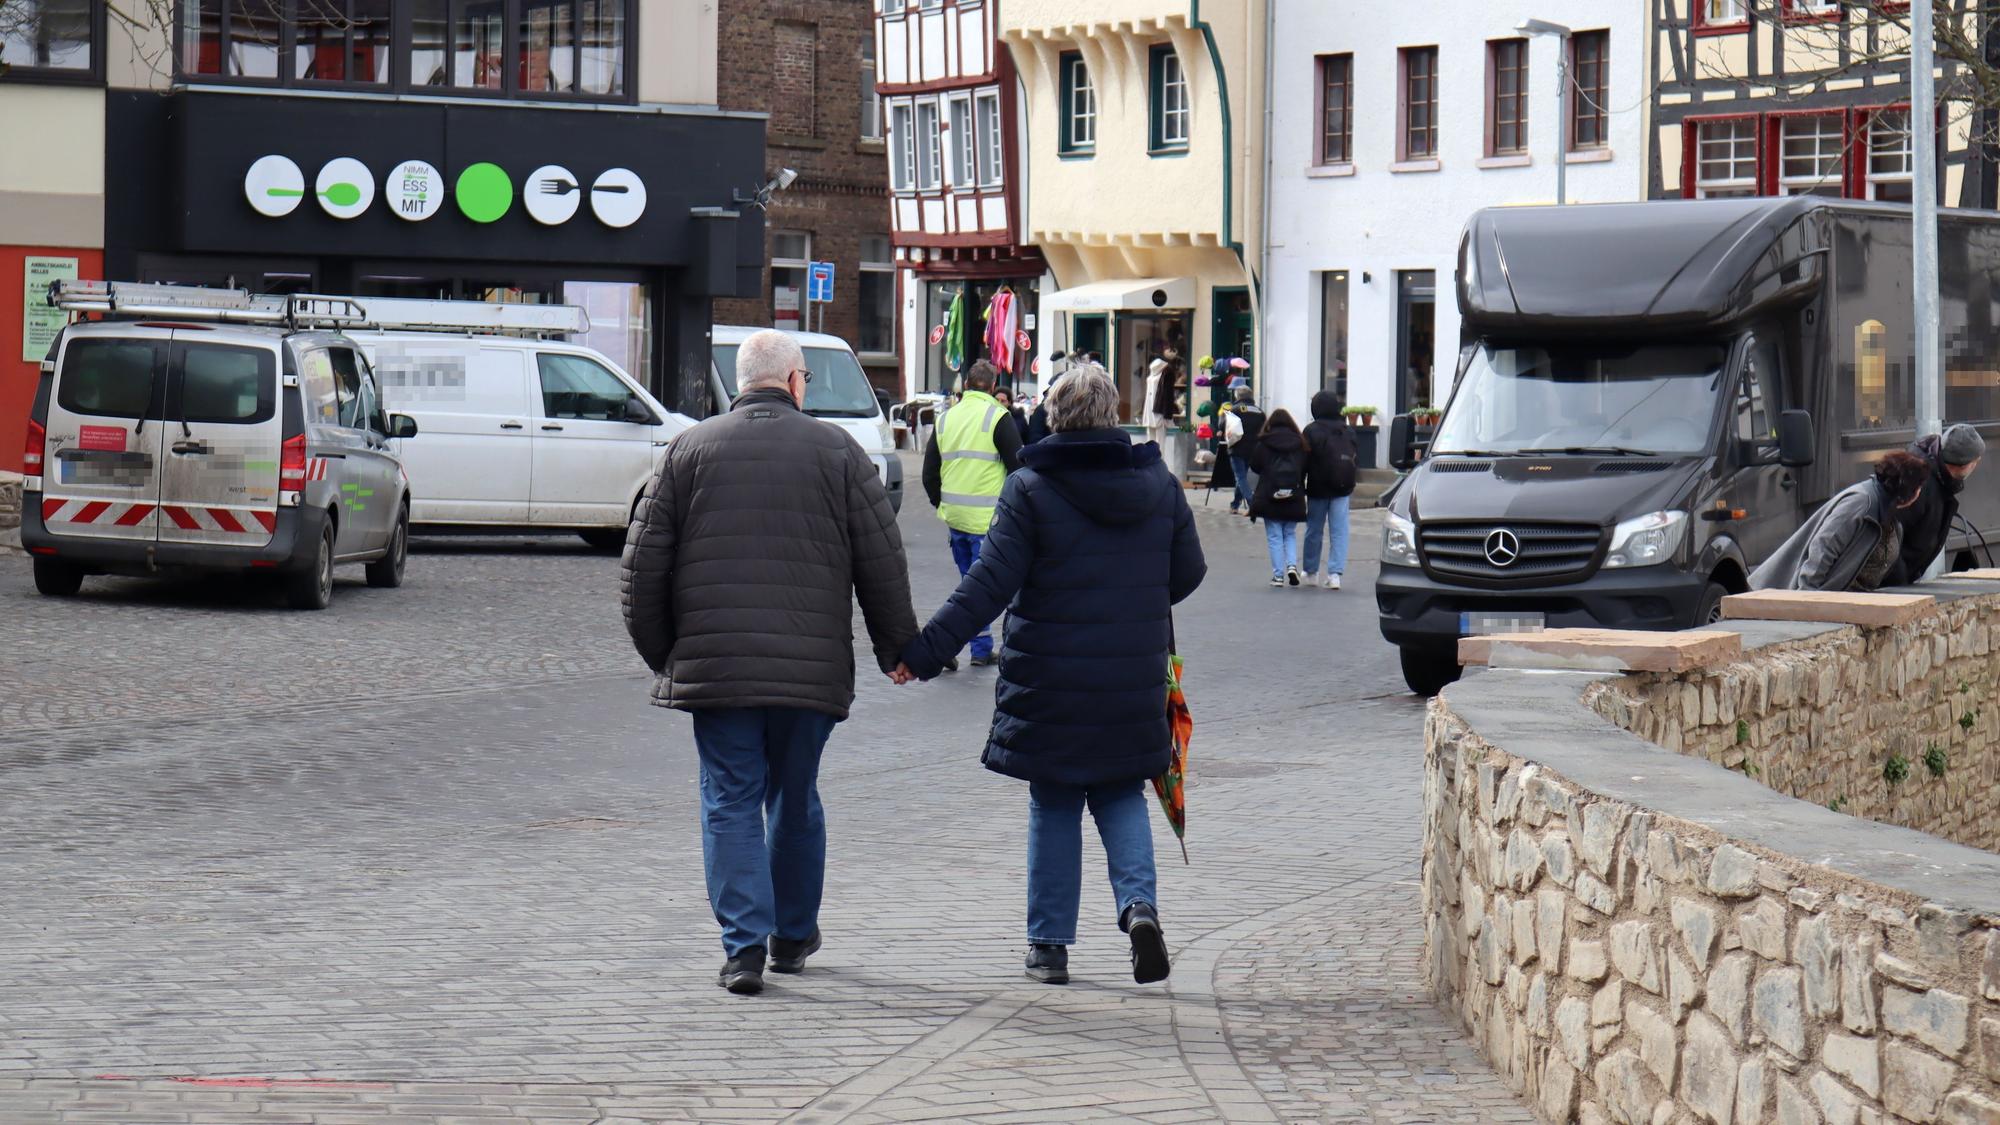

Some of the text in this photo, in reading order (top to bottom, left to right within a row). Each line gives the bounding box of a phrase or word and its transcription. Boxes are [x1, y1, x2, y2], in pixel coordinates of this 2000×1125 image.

[403, 165, 429, 175] NIMM
[402, 179, 428, 192] ESS
[401, 198, 427, 213] MIT
